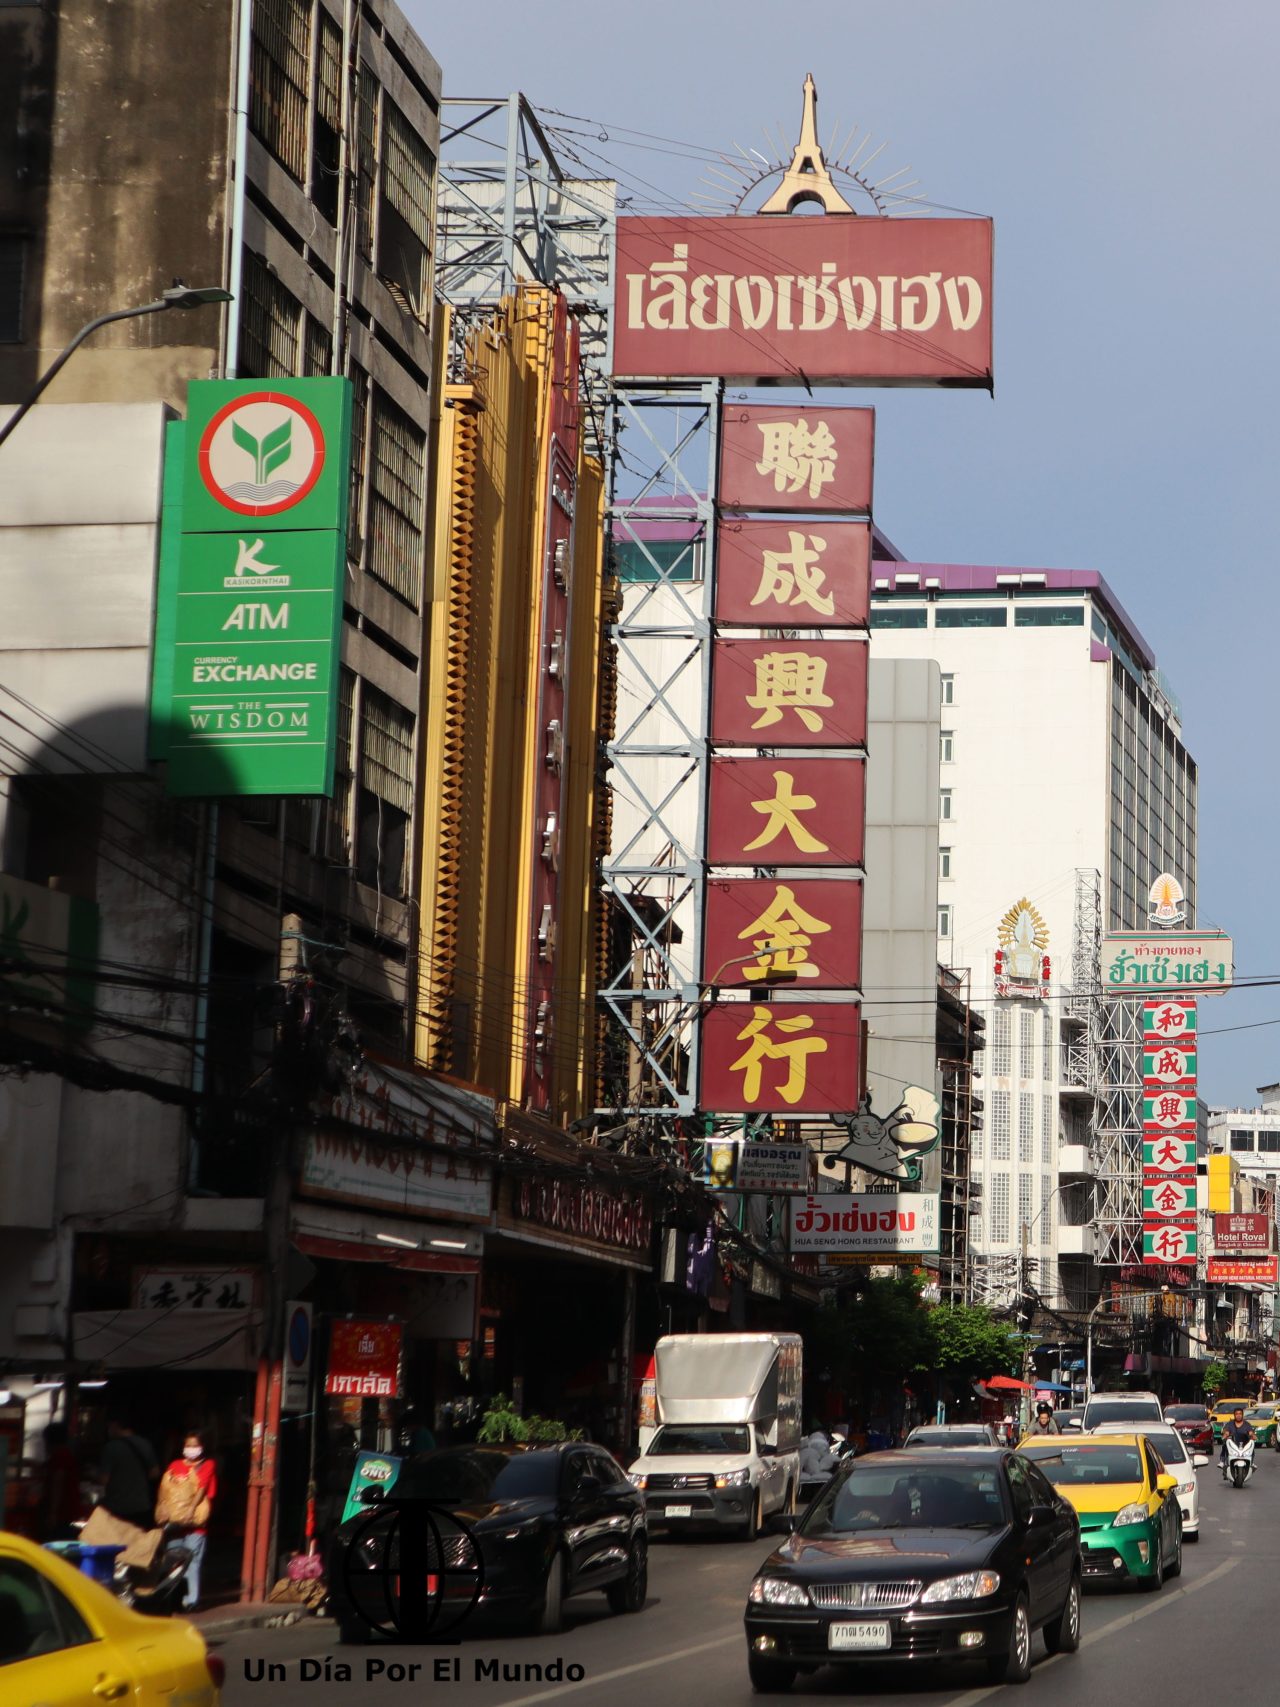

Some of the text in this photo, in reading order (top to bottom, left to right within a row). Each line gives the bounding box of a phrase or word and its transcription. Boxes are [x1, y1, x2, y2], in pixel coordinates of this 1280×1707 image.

[625, 243, 983, 332] เลี่ยงเซ่งเฮง
[225, 577, 289, 586] KASIKORNTHAI
[221, 603, 289, 630] ATM
[194, 656, 238, 665] CURRENCY
[192, 663, 317, 683] EXCHANGE
[238, 701, 262, 711] THE
[189, 711, 309, 730] WISDOM
[729, 418, 839, 1105] 聯成興大金行
[1134, 943, 1202, 956] ห้างขายทอง
[1109, 949, 1226, 984] ฮั่วเซ่งเฮง
[795, 1196, 916, 1233] ฮั่วเซ่งฮง
[795, 1237, 915, 1246] HUA SENG HONG RESTAURANT
[1218, 1233, 1266, 1243] Hotel Royal
[360, 1467, 393, 1480] ONLY
[859, 1626, 885, 1637] 5490
